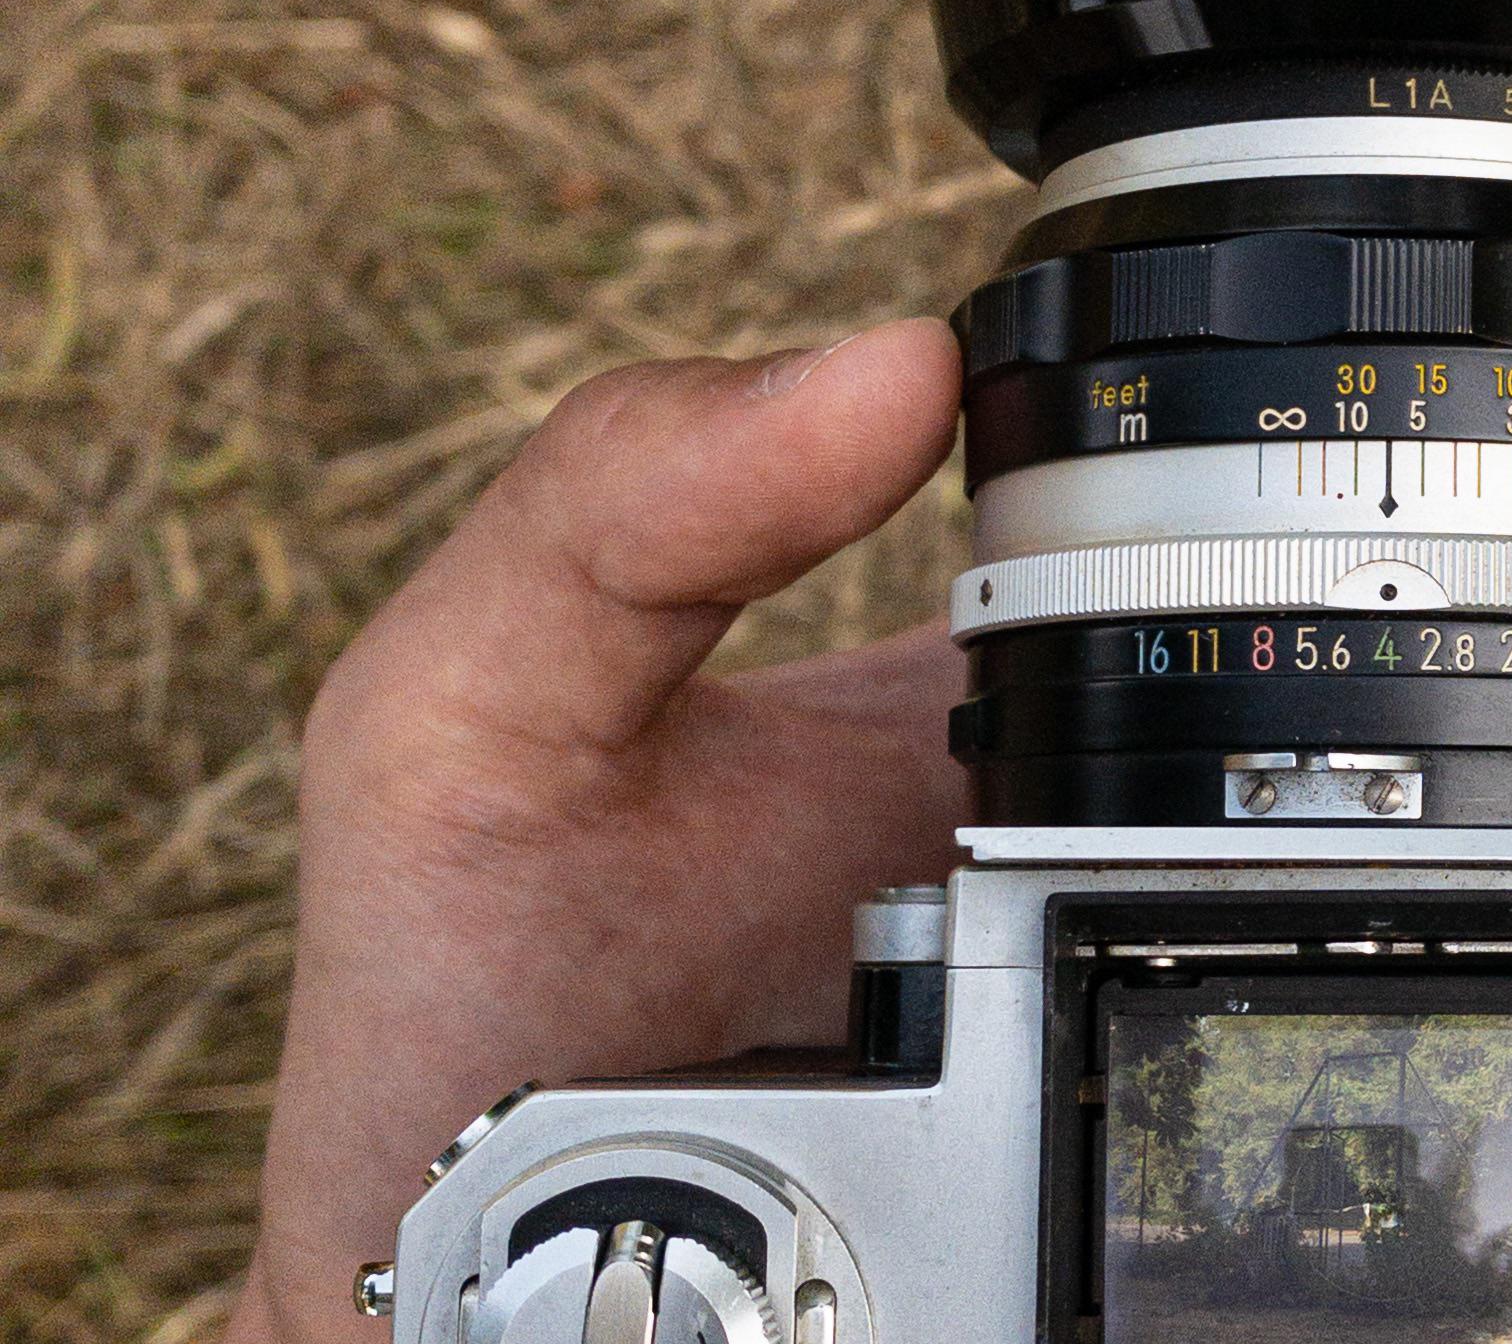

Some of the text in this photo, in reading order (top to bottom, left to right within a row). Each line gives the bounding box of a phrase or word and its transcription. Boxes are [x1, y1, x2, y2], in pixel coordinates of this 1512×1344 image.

[1091, 374, 1149, 410] feet
[1336, 363, 1377, 395] 30
[1414, 363, 1448, 395] 15
[1119, 412, 1147, 443] m
[1334, 401, 1370, 432] 10
[1409, 400, 1427, 432] 5
[1133, 629, 1170, 675] 16
[1187, 629, 1220, 673] 11
[1252, 625, 1276, 672] 8
[1294, 626, 1351, 671] 5.6
[1373, 626, 1402, 671] 4
[1419, 627, 1476, 672] 2.8
